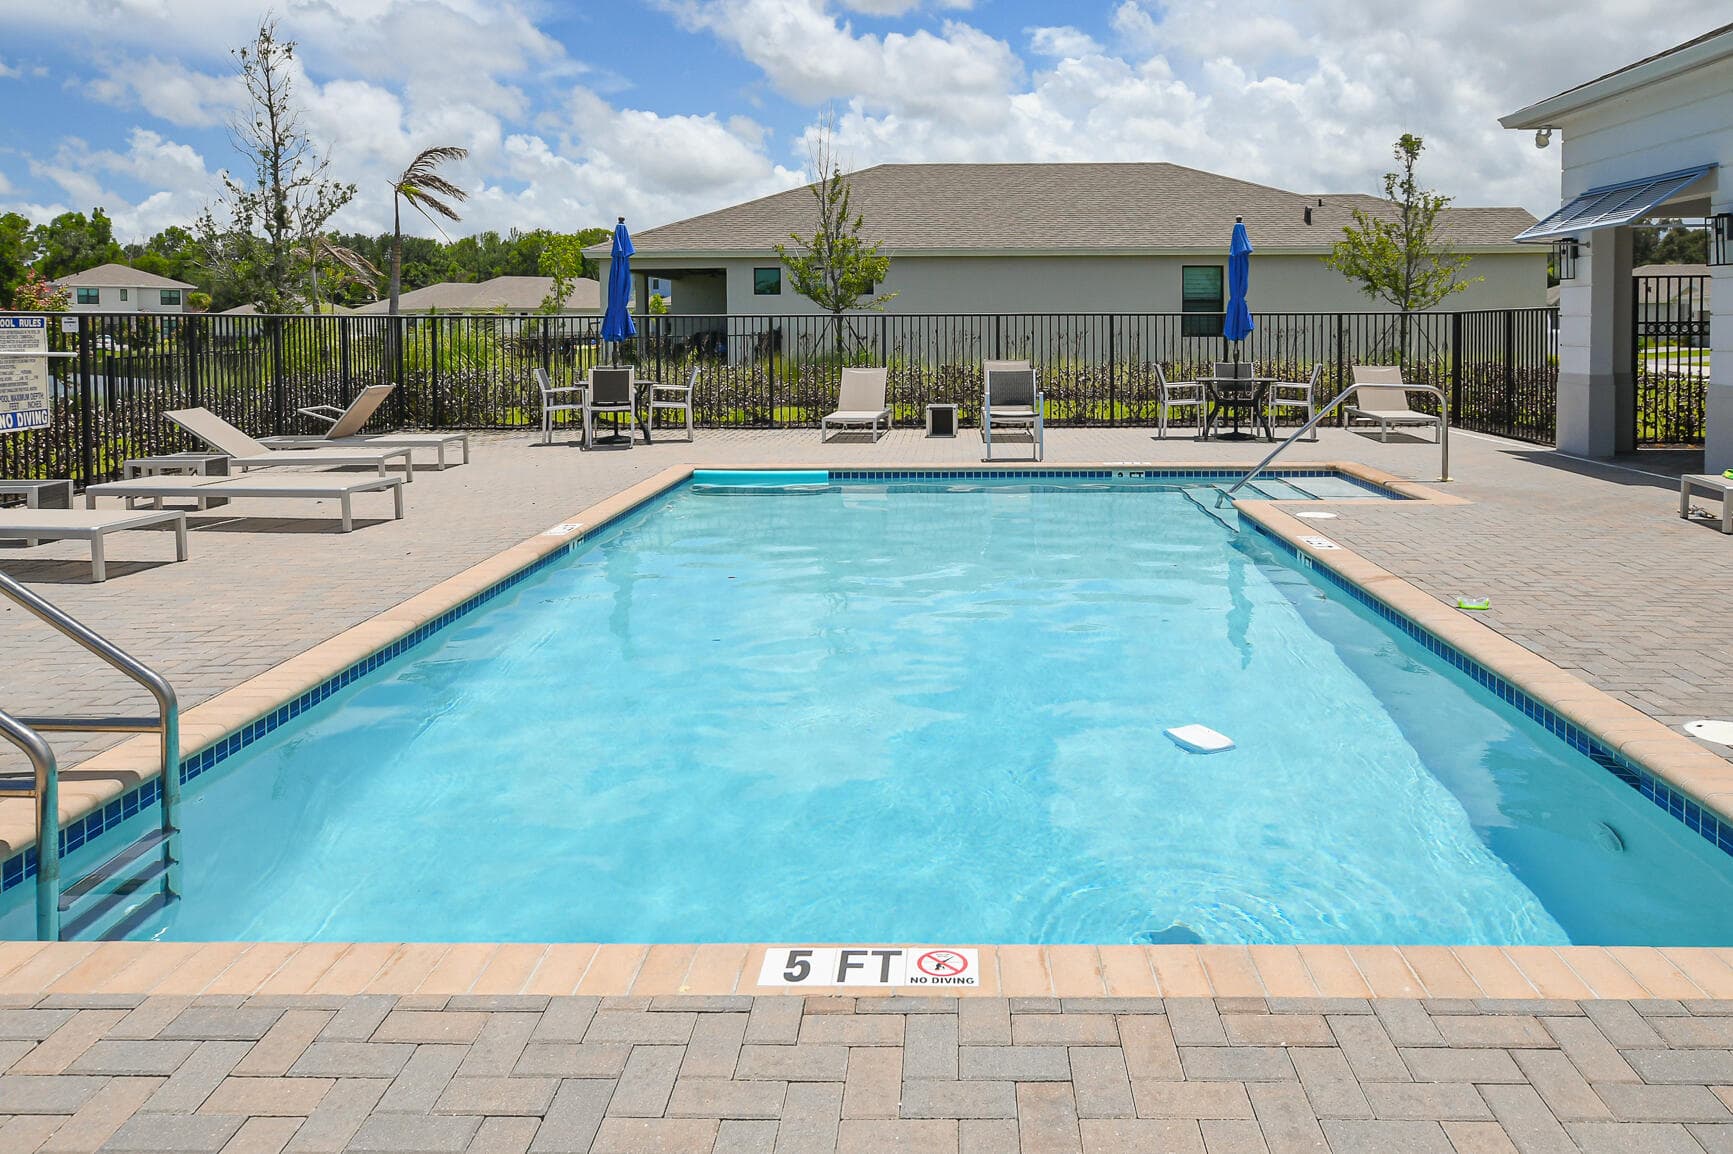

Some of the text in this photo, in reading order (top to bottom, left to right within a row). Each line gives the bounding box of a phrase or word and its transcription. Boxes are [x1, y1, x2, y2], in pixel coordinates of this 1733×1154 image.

[0, 319, 41, 327] OOL RULES
[0, 410, 48, 429] NO DIVING
[783, 950, 902, 983] 5 FT
[910, 977, 975, 985] NO DIVING
